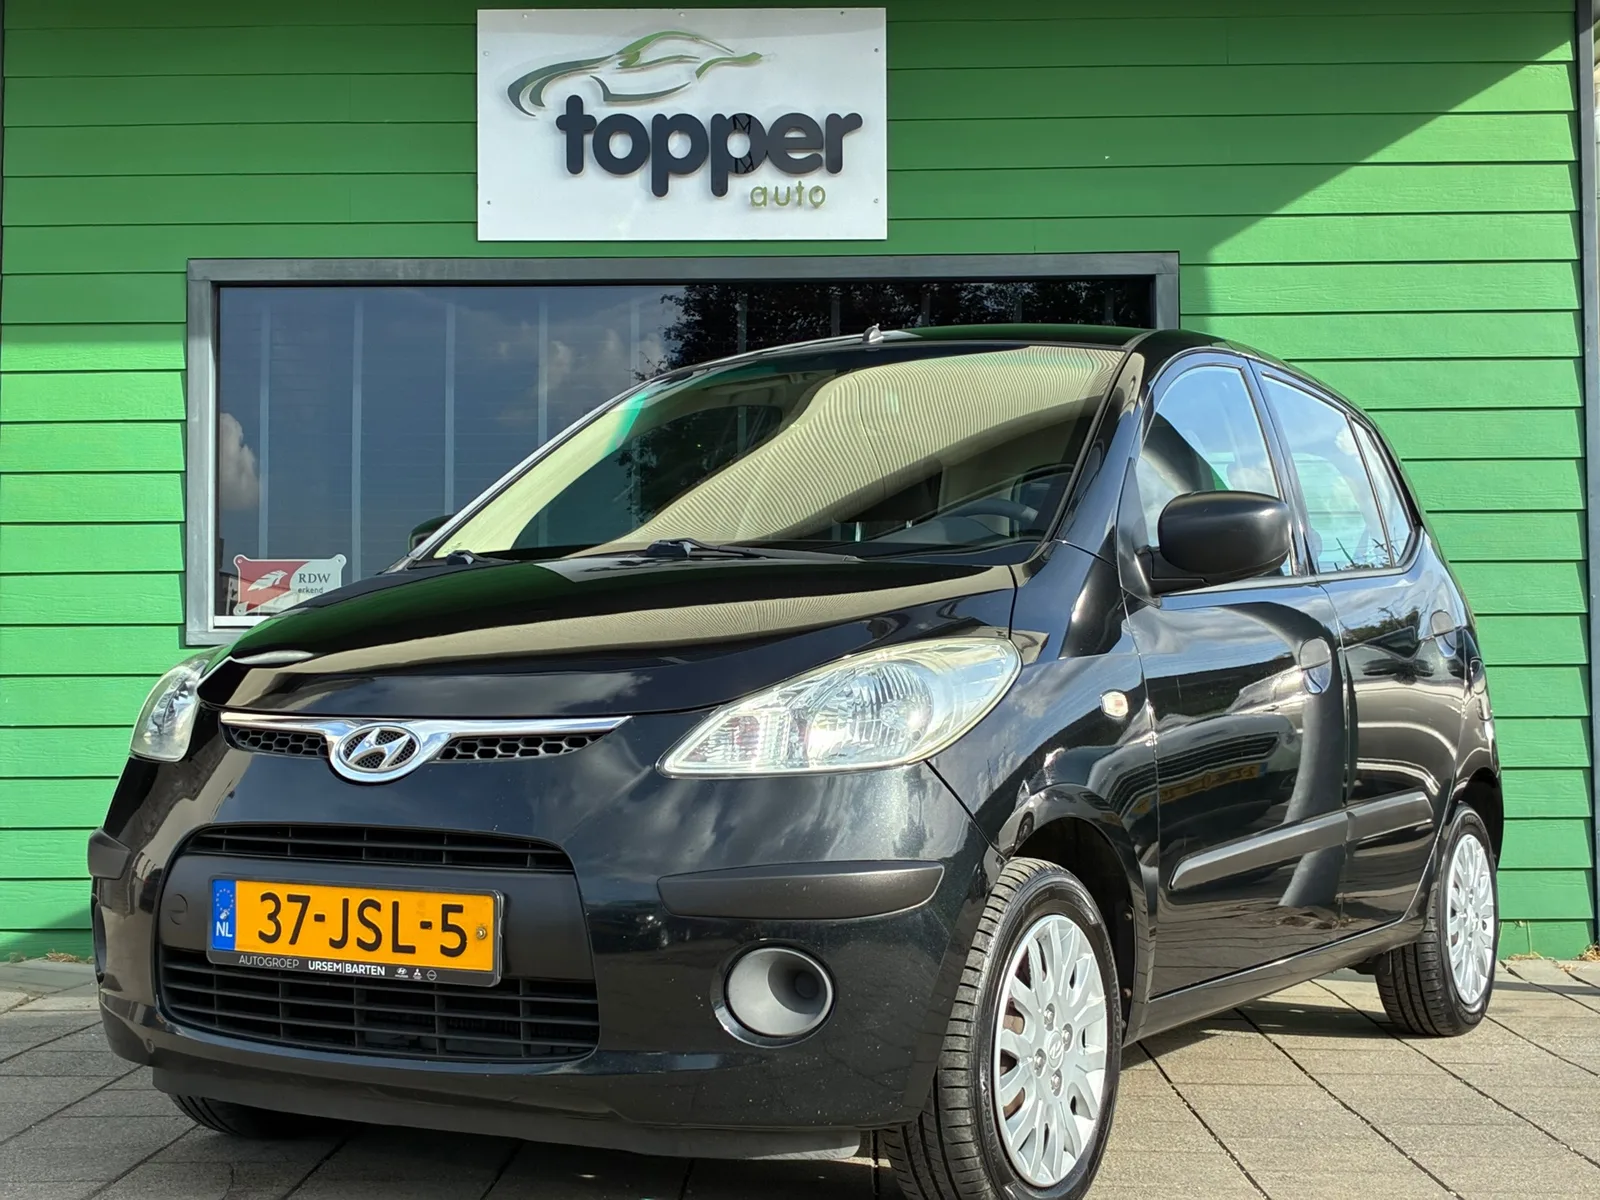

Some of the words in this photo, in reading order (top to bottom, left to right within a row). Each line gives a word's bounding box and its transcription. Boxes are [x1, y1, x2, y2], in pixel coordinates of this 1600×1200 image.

[555, 94, 863, 199] topper
[750, 181, 826, 209] auto
[298, 573, 331, 584] RDW
[297, 586, 324, 595] erkend
[216, 921, 233, 938] NL
[258, 891, 468, 958] 37-JSL-5
[239, 954, 300, 969] AUTOGROEP
